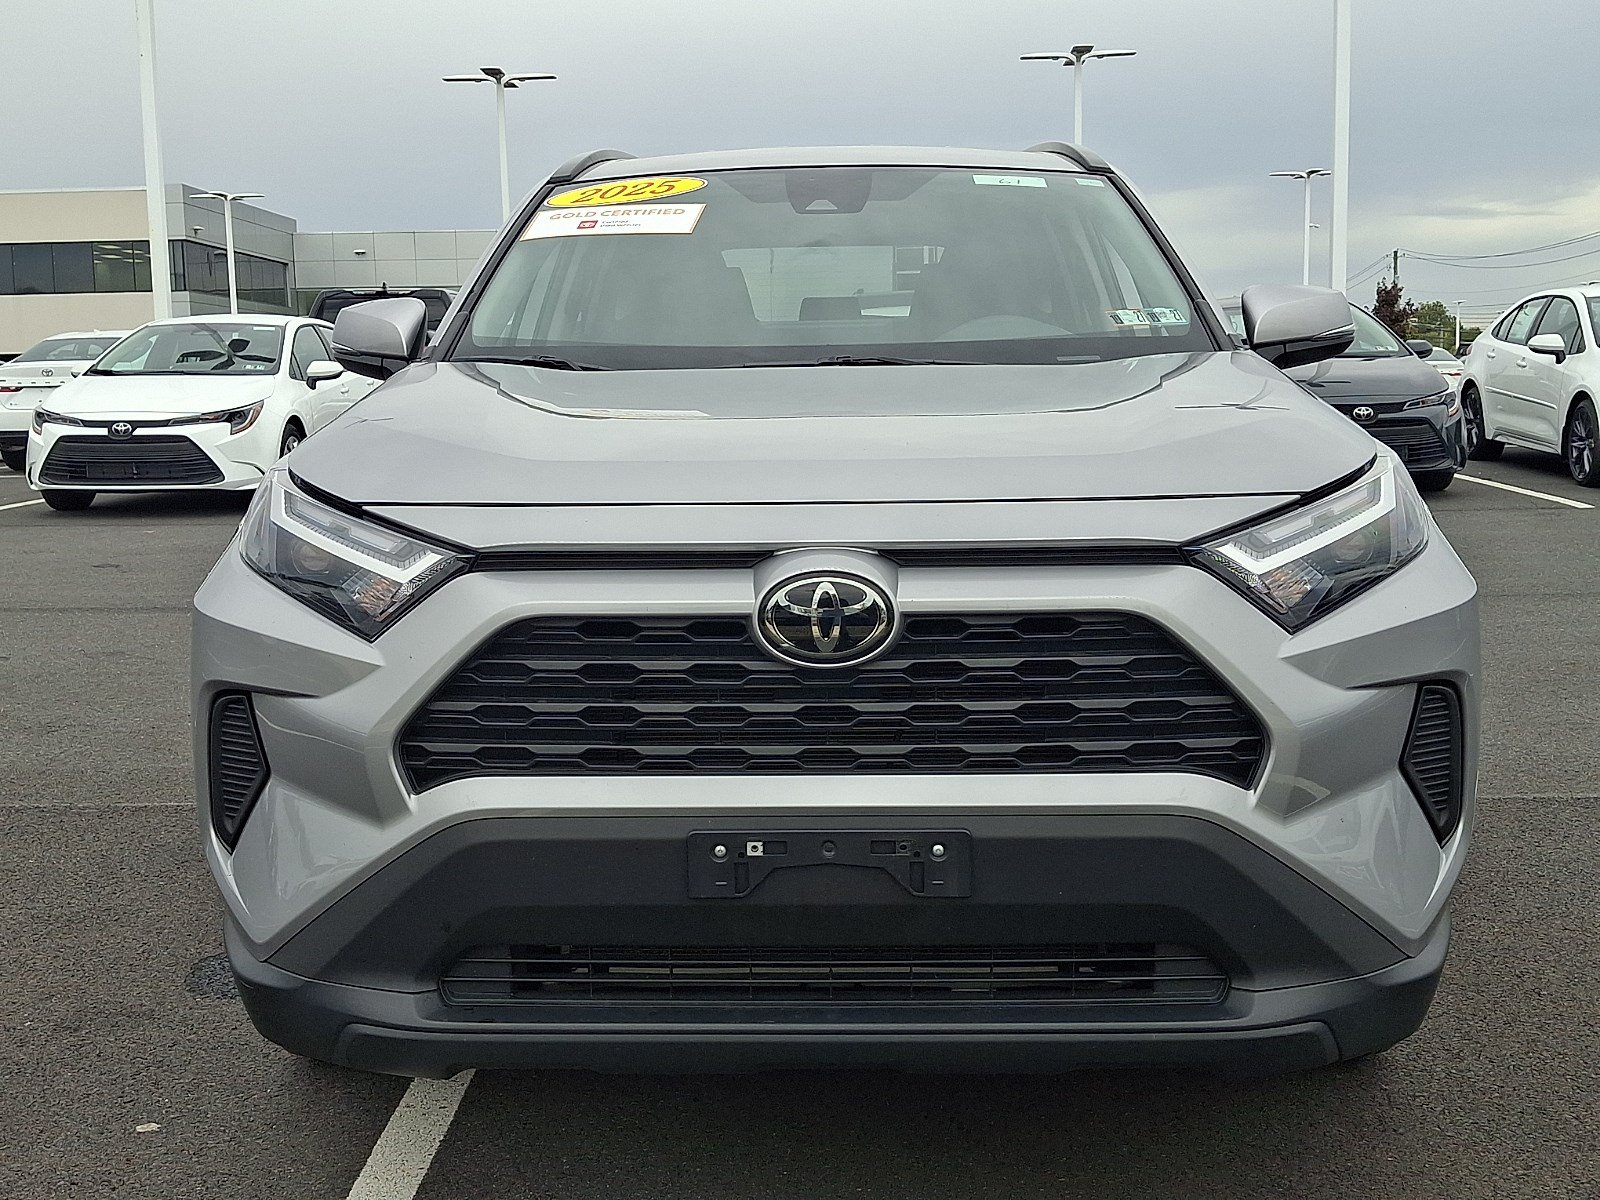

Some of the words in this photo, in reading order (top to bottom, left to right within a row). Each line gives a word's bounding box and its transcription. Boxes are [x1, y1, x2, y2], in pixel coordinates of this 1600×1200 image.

[570, 179, 682, 204] 2025
[549, 210, 597, 220] GOLD
[600, 208, 686, 217] CERTIFIED
